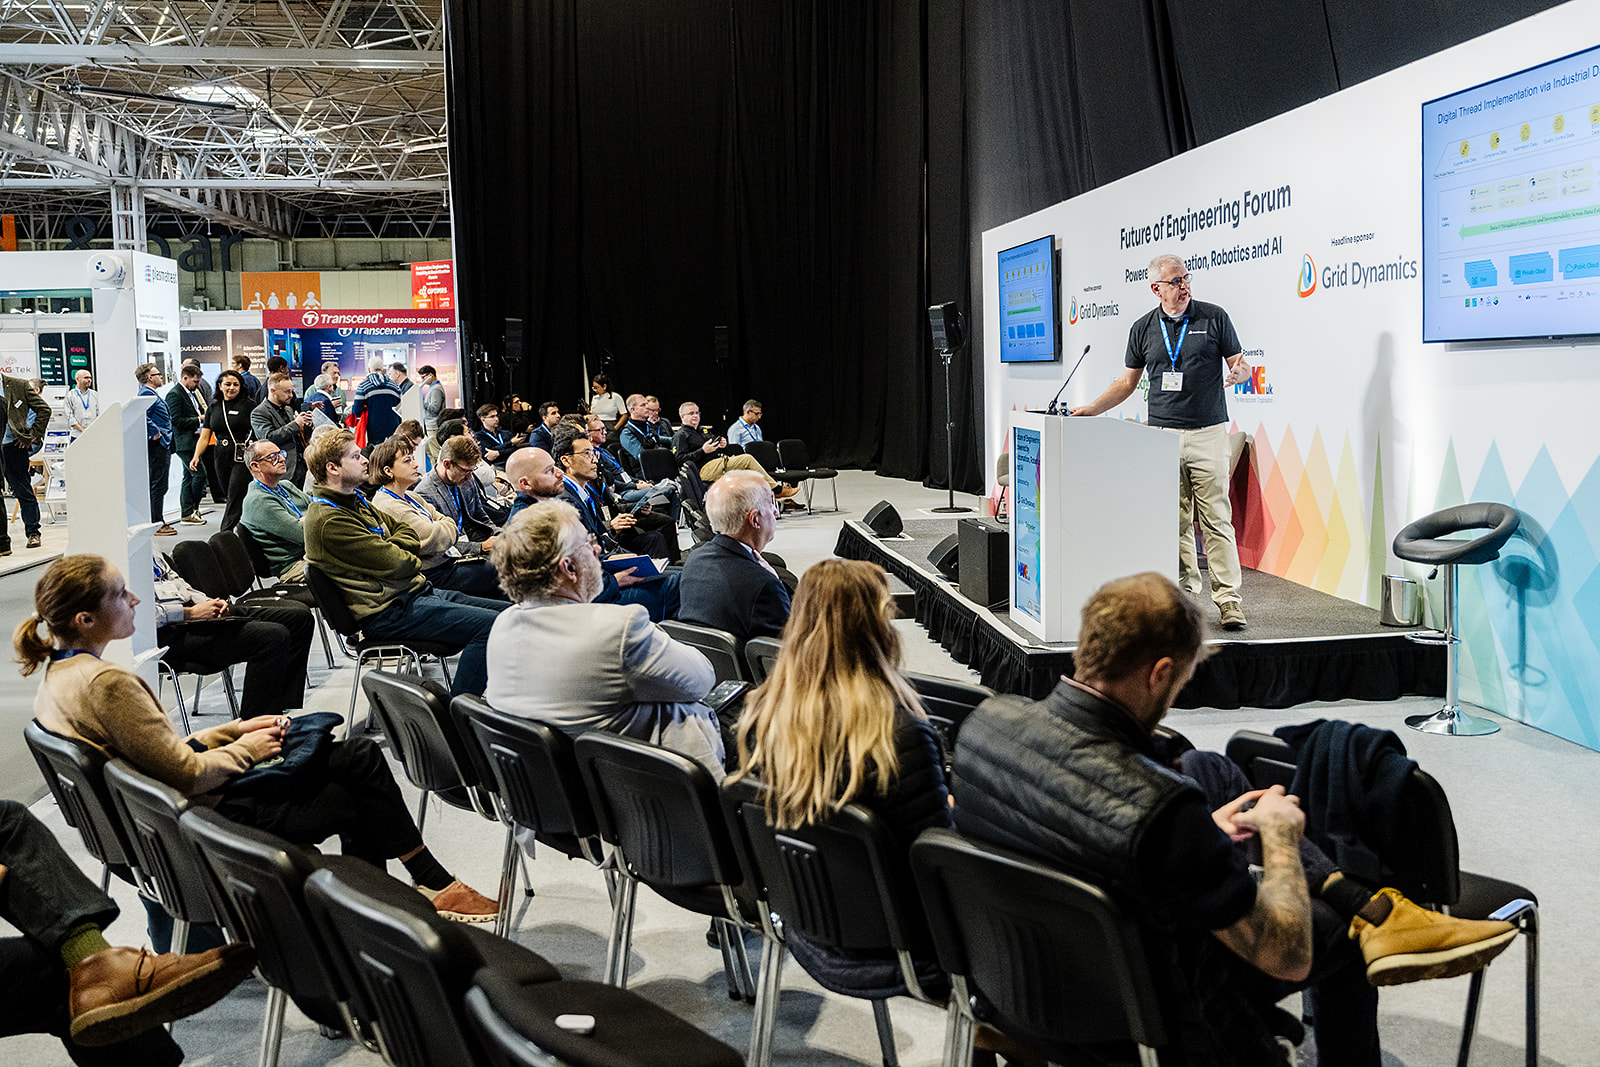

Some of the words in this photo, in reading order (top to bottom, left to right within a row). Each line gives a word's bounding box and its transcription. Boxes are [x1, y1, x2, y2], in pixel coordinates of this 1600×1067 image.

[1437, 109, 1457, 125] Digital
[1459, 101, 1482, 118] Thread
[1484, 86, 1538, 111] Implementation
[1539, 81, 1551, 93] via
[1553, 67, 1590, 88] Industrial
[1592, 65, 1600, 77] D
[1120, 225, 1151, 250] Future
[1153, 216, 1165, 242] of
[1166, 198, 1240, 243] Engineering
[1244, 185, 1291, 218] Forum
[1331, 237, 1353, 248] Headline
[1353, 232, 1375, 245] sponsor
[1125, 268, 1148, 283] Powere
[1184, 253, 1210, 272] ation,
[1211, 244, 1250, 268] Robotics
[1251, 239, 1269, 259] and
[1271, 236, 1282, 256] AI
[1322, 263, 1347, 289] Grid
[1352, 255, 1417, 290] Dynamics
[321, 313, 379, 324] Transcend
[1080, 303, 1091, 320] Grid
[1092, 300, 1119, 321] Dynamics
